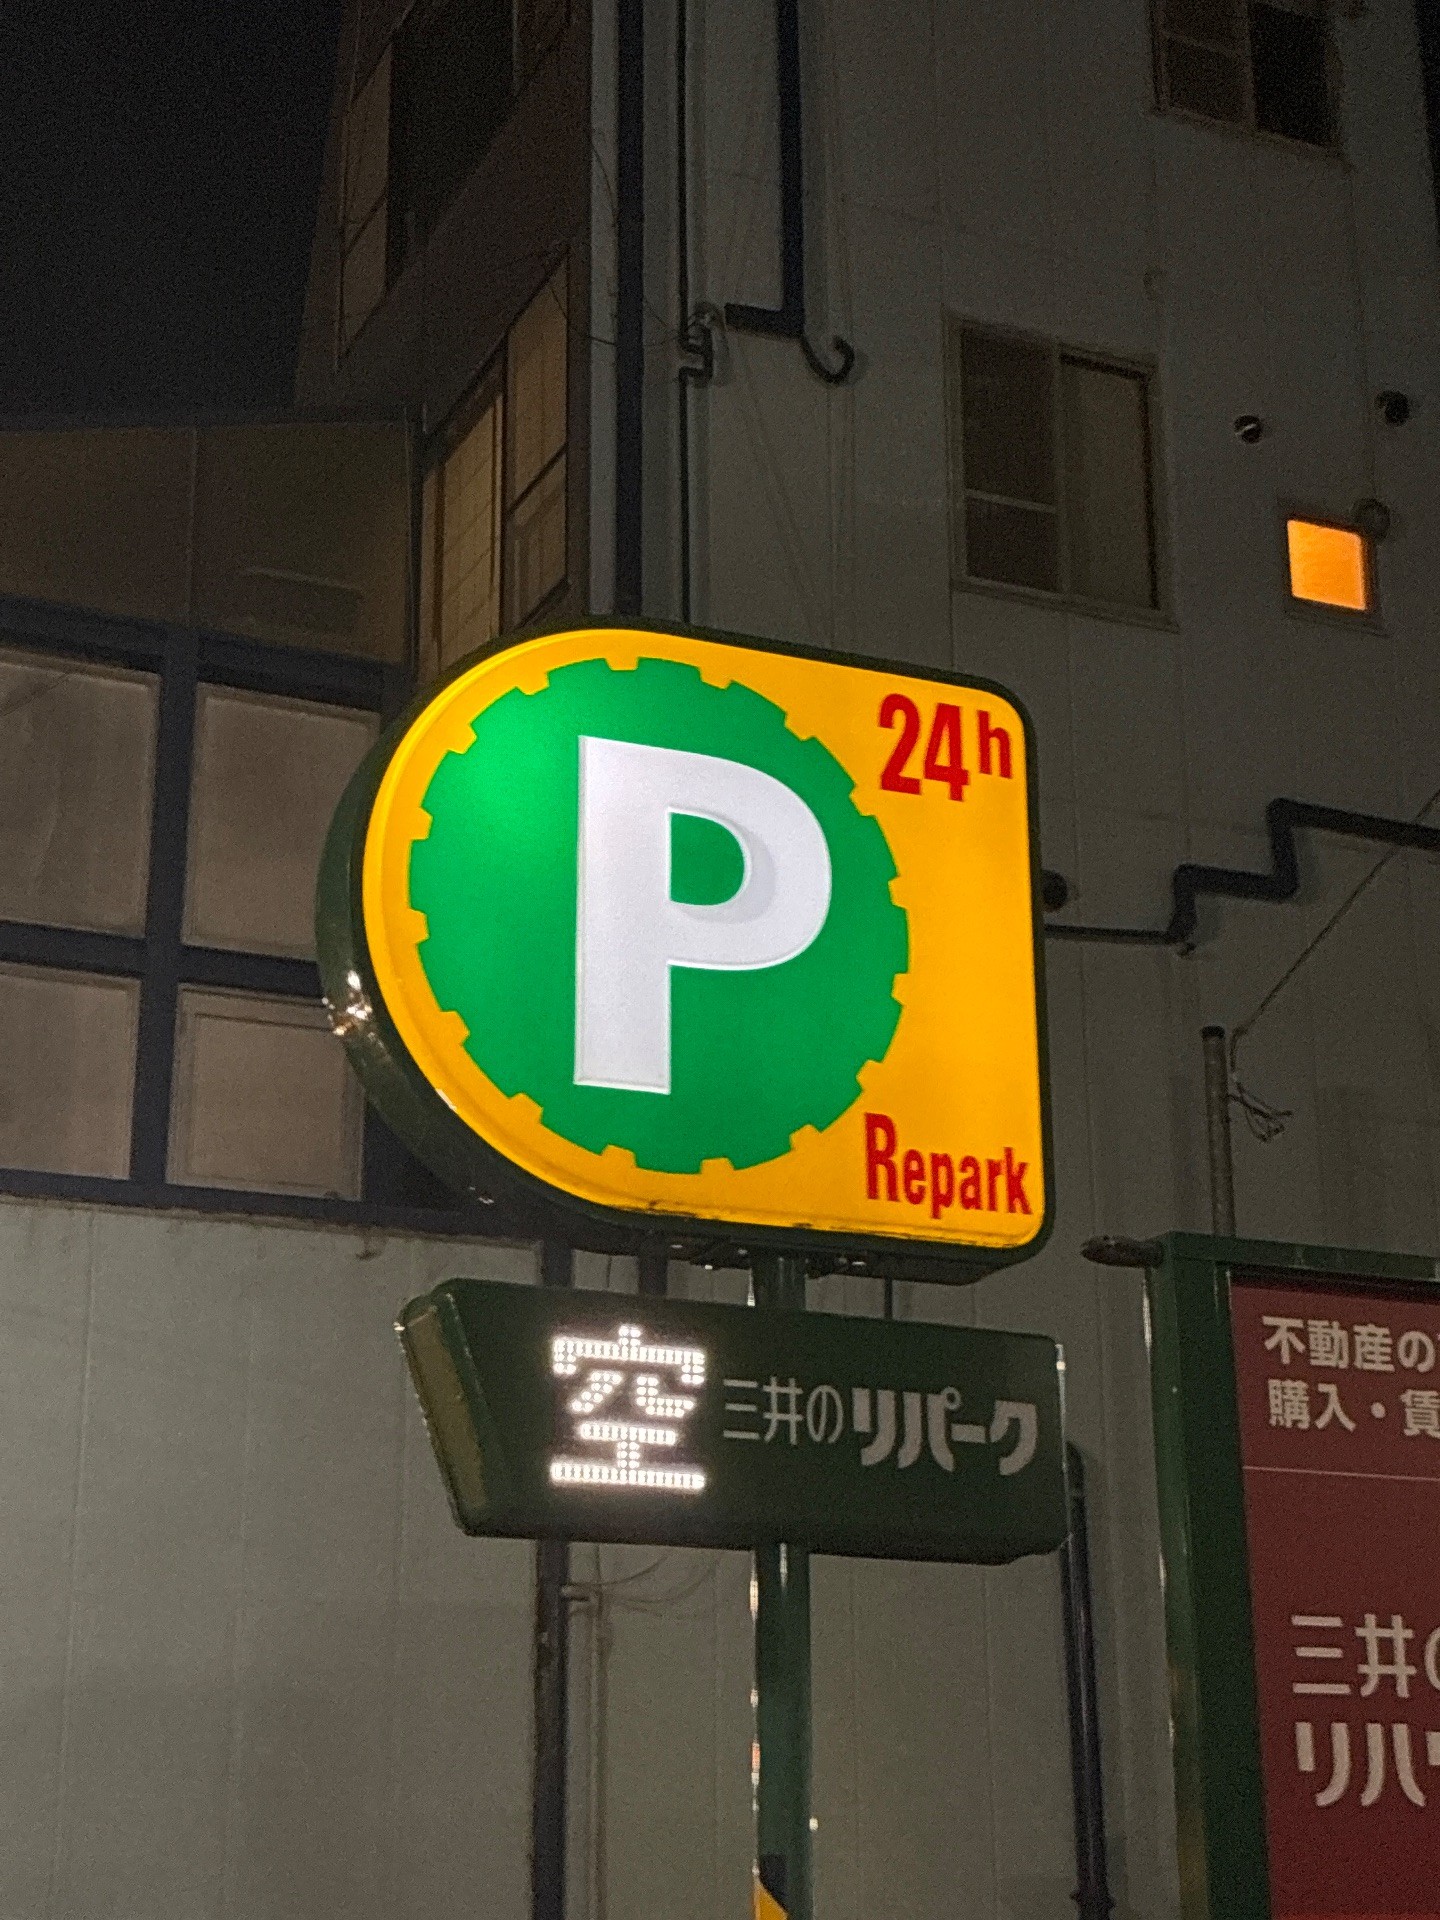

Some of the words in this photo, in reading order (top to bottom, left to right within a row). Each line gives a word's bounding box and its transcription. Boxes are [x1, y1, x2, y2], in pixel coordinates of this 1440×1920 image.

[878, 693, 1013, 802] 24h
[573, 735, 832, 1094] P
[864, 1112, 1033, 1220] Repark
[1261, 1315, 1436, 1373] 不動産の
[550, 1323, 706, 1490] 空
[722, 1375, 1038, 1476] 三井のリパーク
[1295, 1722, 1440, 1807] リハ
